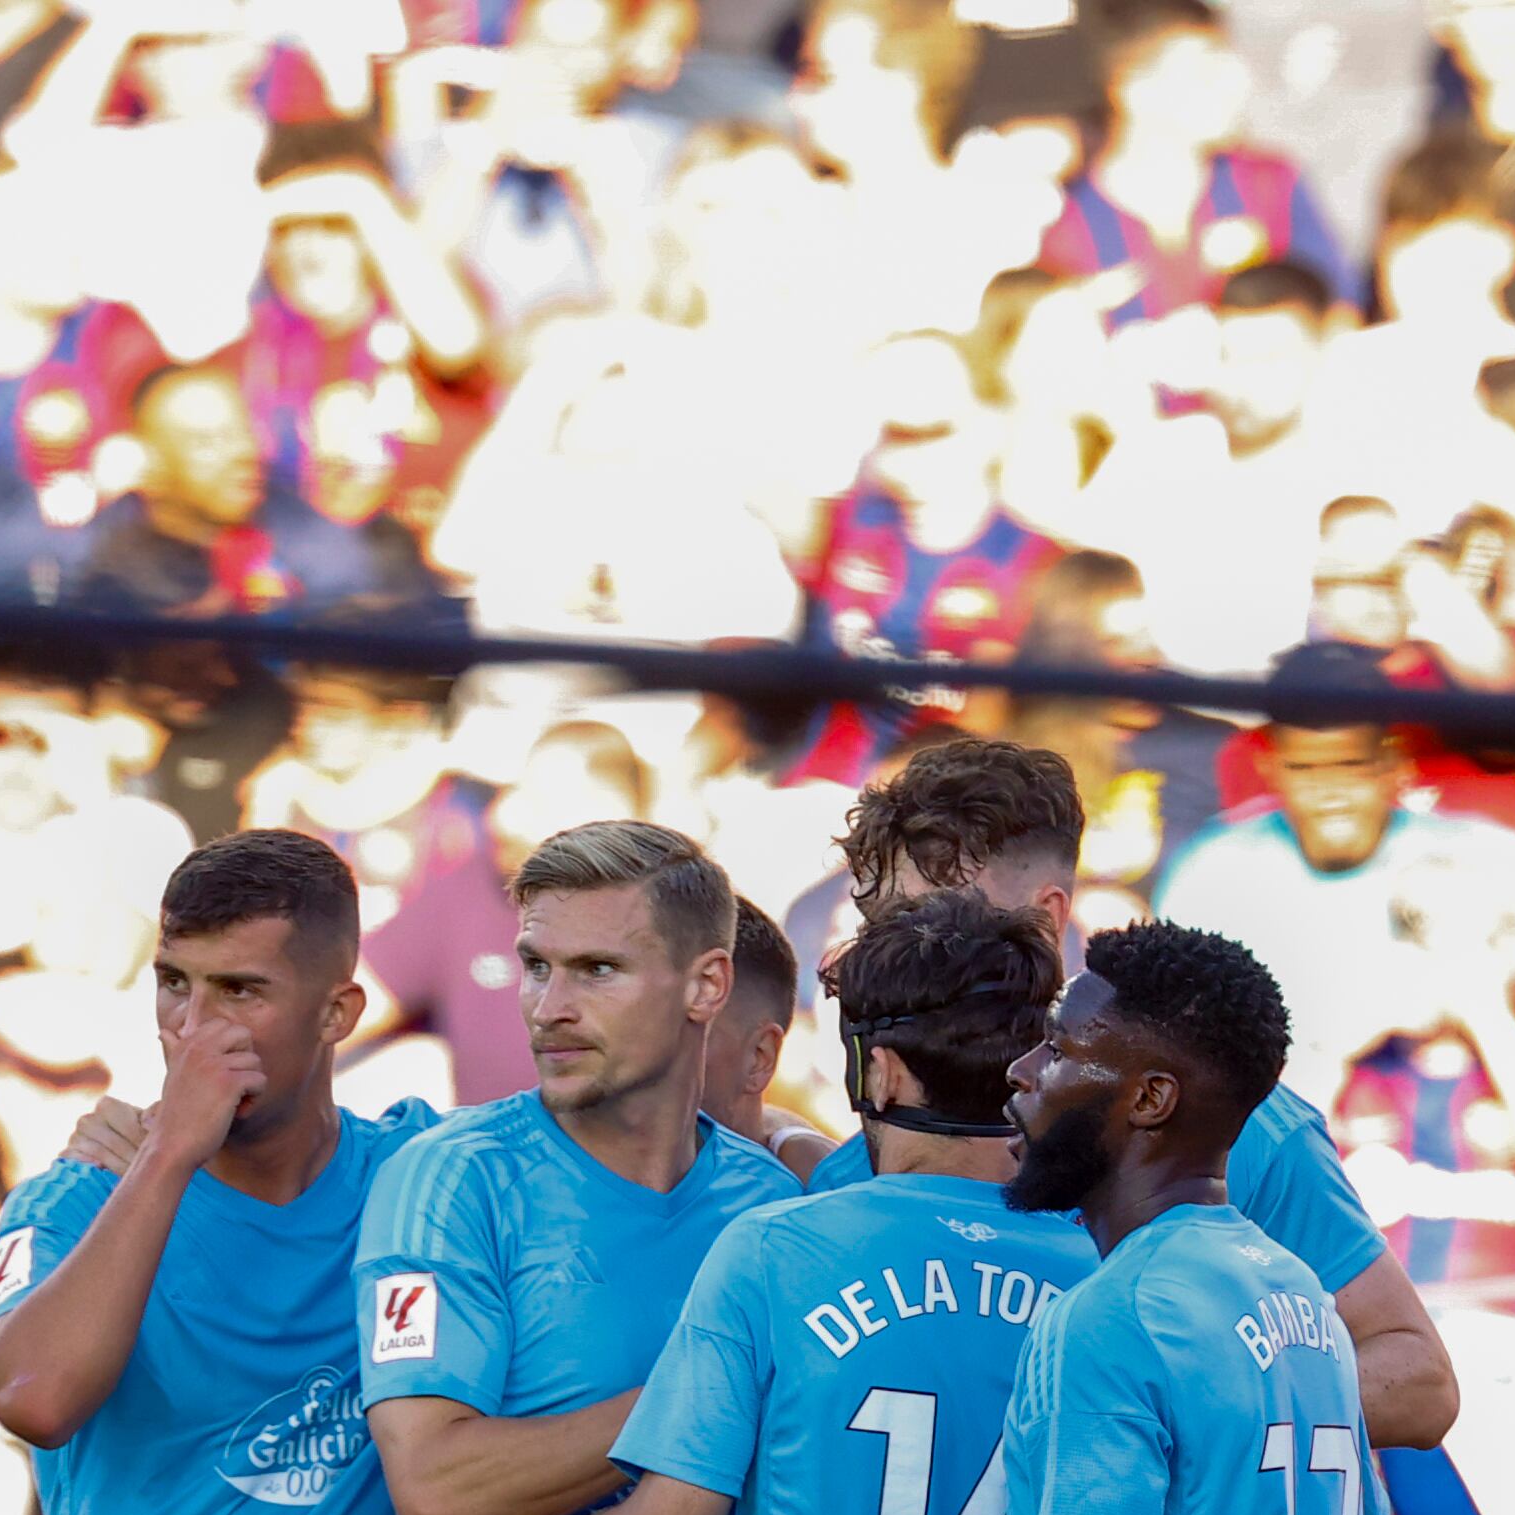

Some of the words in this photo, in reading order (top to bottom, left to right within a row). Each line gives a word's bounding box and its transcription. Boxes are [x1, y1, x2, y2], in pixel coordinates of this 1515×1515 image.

[379, 1334, 428, 1353] LALIGA
[802, 1278, 889, 1360] DE
[882, 1258, 960, 1320] LA
[1233, 1290, 1341, 1373] BAMBA
